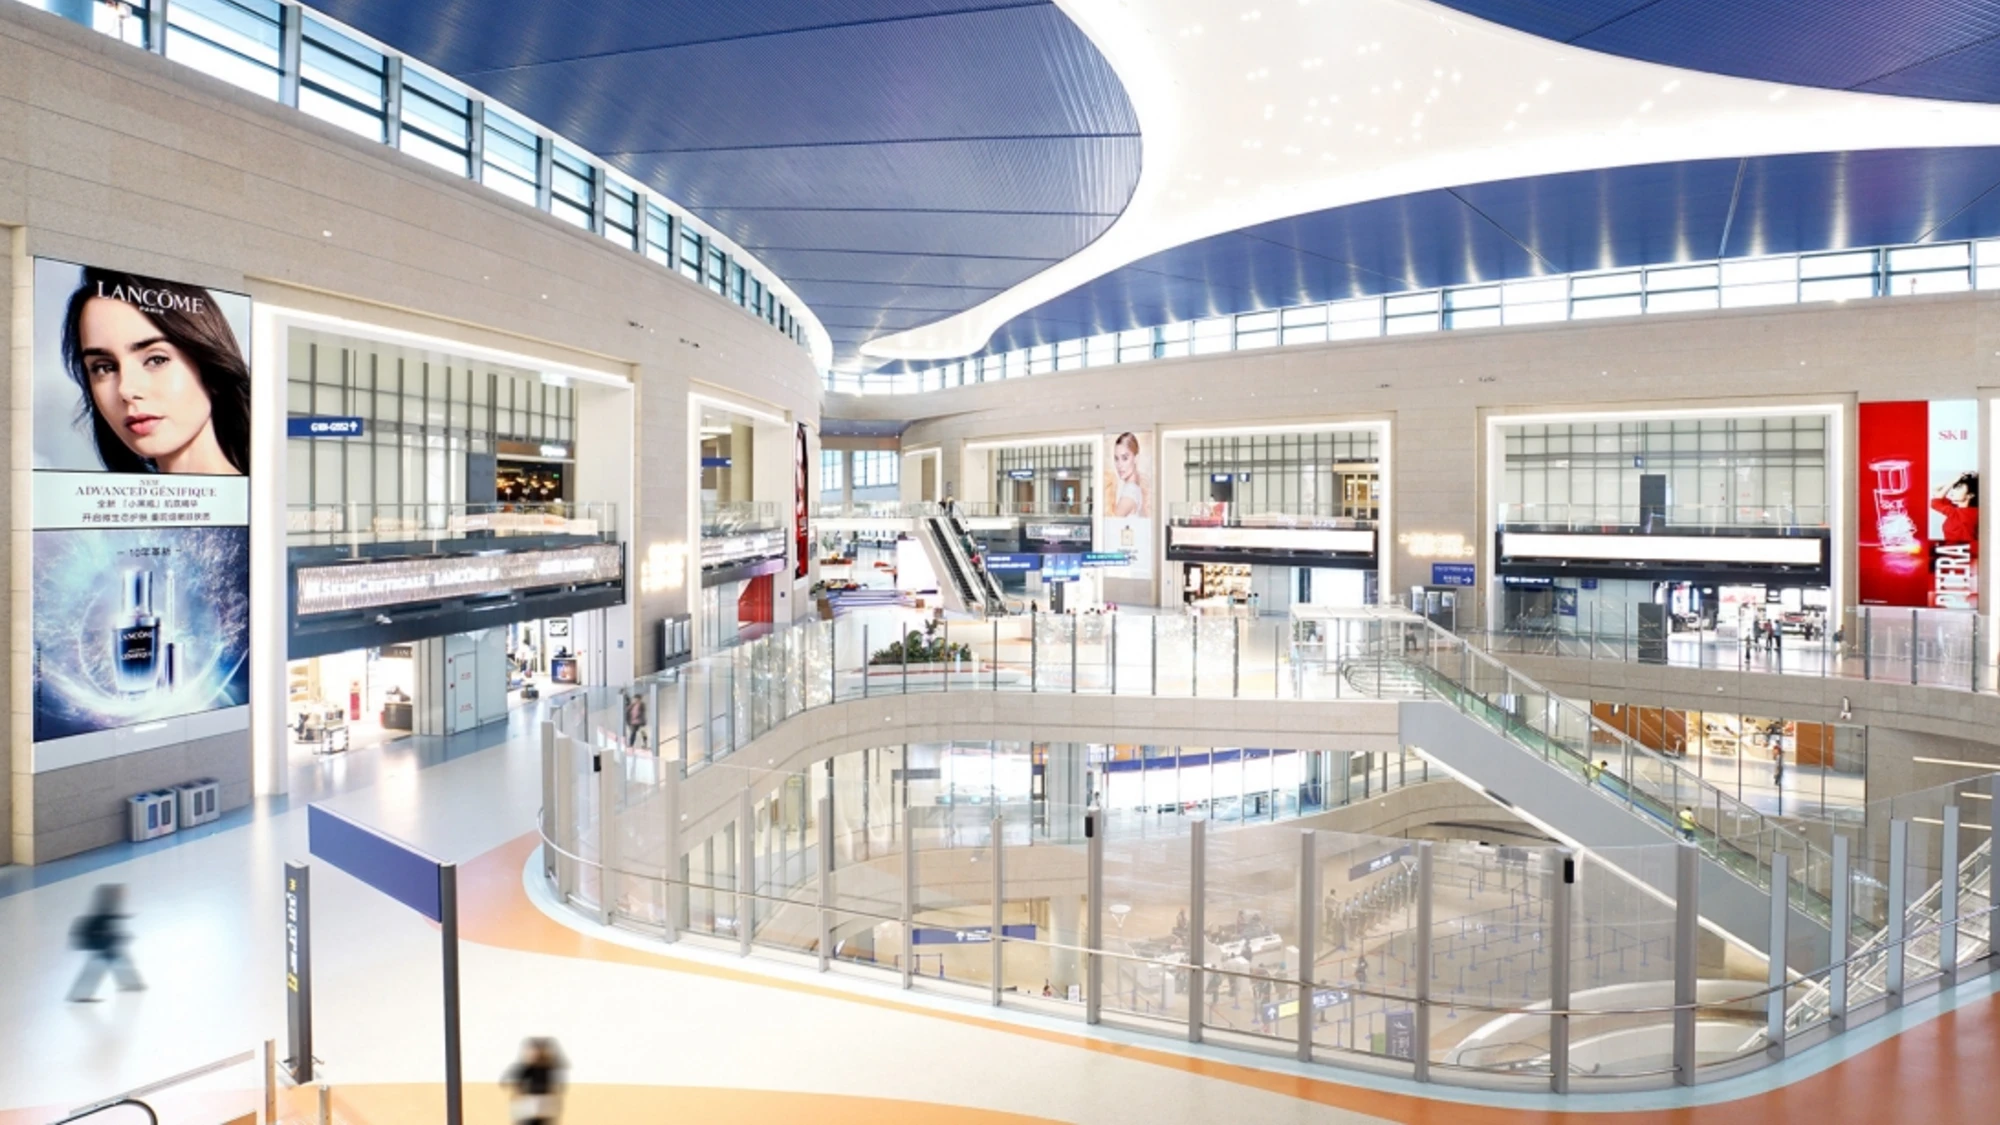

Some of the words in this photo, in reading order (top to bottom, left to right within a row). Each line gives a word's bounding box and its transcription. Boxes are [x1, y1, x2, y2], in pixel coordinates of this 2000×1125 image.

[97, 280, 204, 314] LANCÔME
[75, 486, 148, 496] ADVANCED
[150, 485, 217, 497] GÉNIFIQUE
